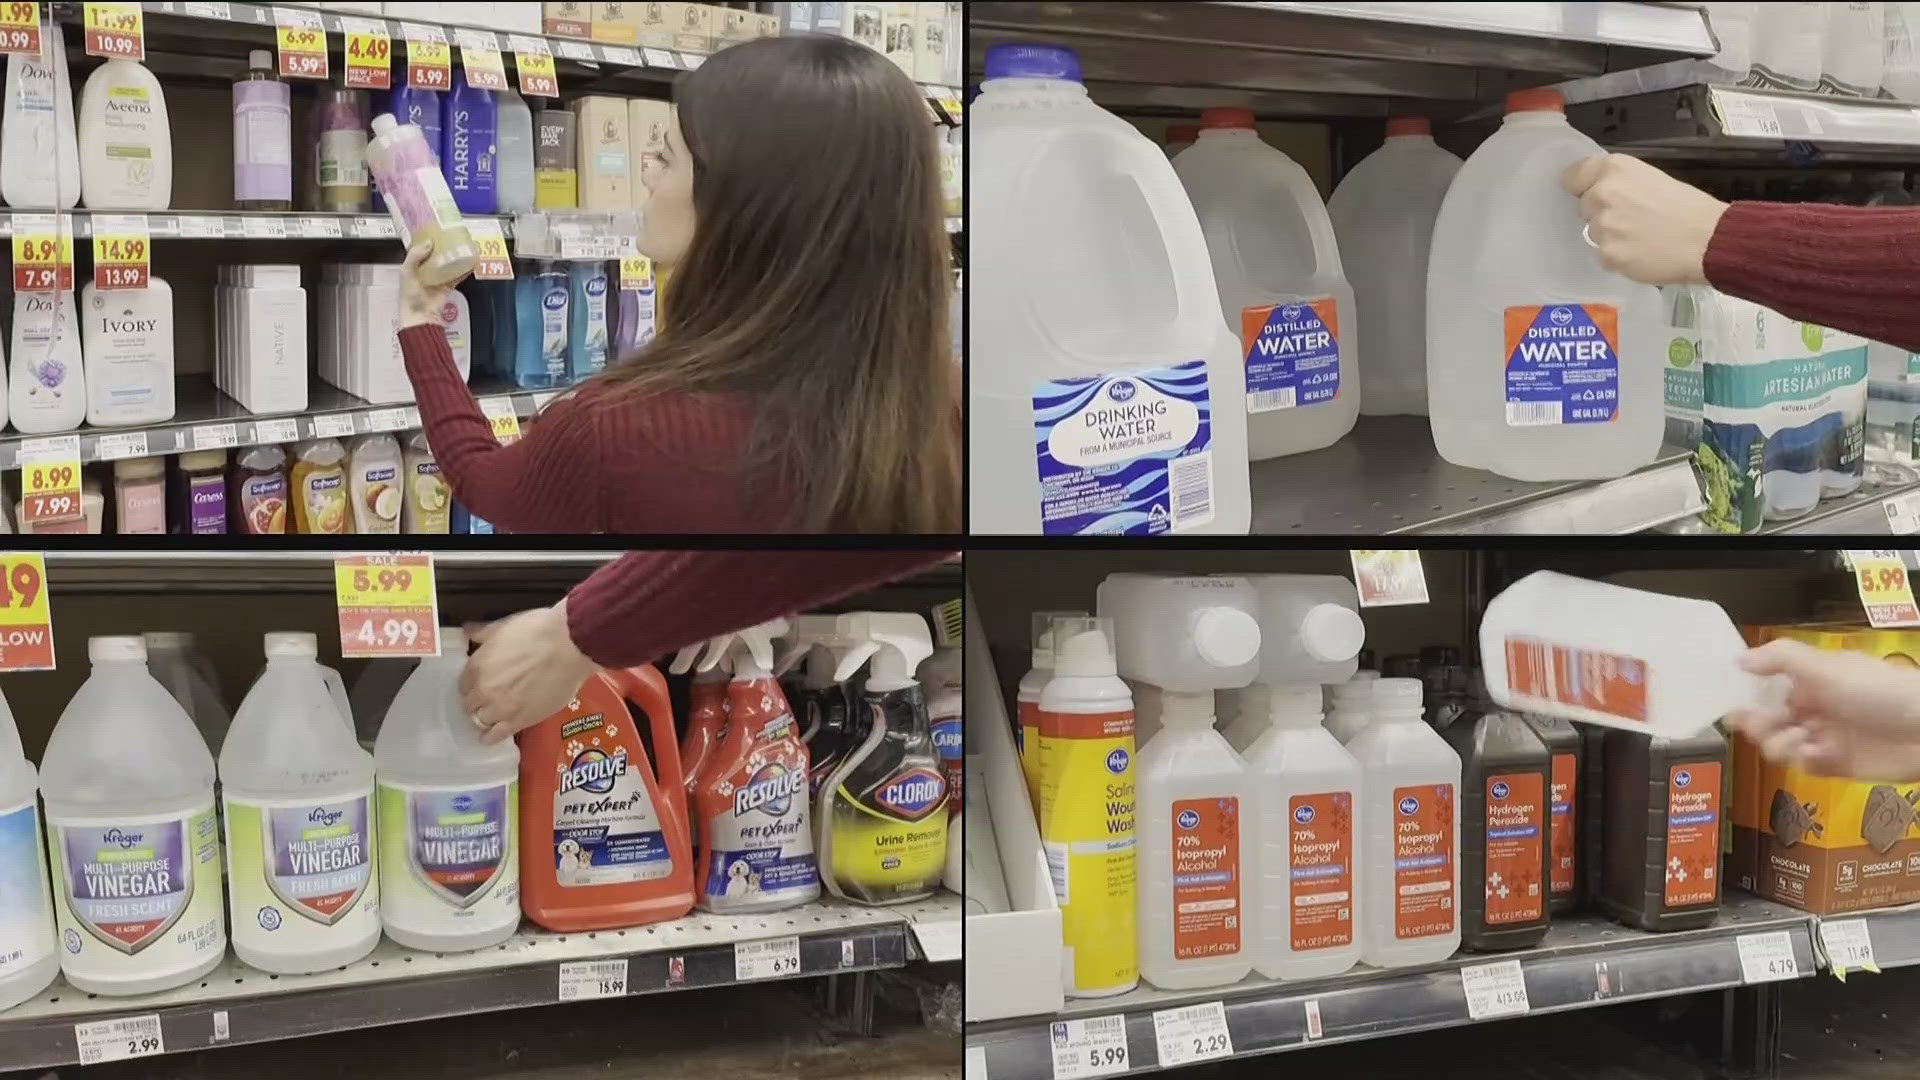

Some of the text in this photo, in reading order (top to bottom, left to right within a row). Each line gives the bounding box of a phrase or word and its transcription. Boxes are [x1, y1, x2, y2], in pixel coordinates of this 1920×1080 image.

[97, 35, 133, 53] 10.99
[286, 31, 316, 45] 6.99
[349, 37, 388, 60] 4.49
[288, 57, 319, 73] 5.99
[349, 76, 372, 84] PRICE
[416, 69, 443, 84] 5.99
[473, 71, 499, 85] 5.99
[527, 78, 550, 91] 5.99
[105, 100, 151, 114] Aveeno
[100, 240, 144, 260] 14.99
[480, 262, 505, 275] 7.99
[624, 260, 646, 272] 6.99
[105, 269, 139, 285] 13.99
[102, 318, 157, 333] IVORY
[1264, 320, 1321, 335] DISTILLED
[1529, 325, 1596, 338] DISTILLED
[274, 321, 286, 365] NATIVE
[1257, 331, 1330, 356] WATER
[1520, 340, 1607, 362] WATER
[1085, 400, 1167, 428] DRINKING
[1099, 419, 1155, 441] WATER
[128, 445, 146, 454] 7.99
[1079, 431, 1172, 457] FROM A MUNICIPAL SOURCE
[32, 466, 72, 489] 8.99
[194, 491, 224, 504] Caress
[34, 496, 71, 516] 7.99
[367, 556, 398, 566] SALE
[353, 569, 412, 592] 5.99
[1861, 567, 1904, 592] 5.99
[358, 619, 419, 646] 4.99
[561, 756, 626, 793] RESOLVE
[736, 772, 803, 816] RESOLVE
[886, 780, 940, 805] CLOROX
[1671, 793, 1712, 806] Hydrogen
[563, 803, 586, 815] PET
[1489, 804, 1534, 817] Hydrogen
[1671, 803, 1707, 813] Peroxide
[309, 807, 343, 826] Kroger
[1489, 815, 1529, 827] Peroxide
[741, 827, 761, 838] PET
[1398, 821, 1420, 832] 70%
[103, 828, 144, 849] Kroger
[876, 835, 904, 846] Urine
[1177, 836, 1200, 847] 70%
[1293, 831, 1315, 840] 70%
[1398, 830, 1443, 845] Isopropyl
[424, 836, 499, 864] VINEGAR
[1177, 845, 1227, 860] Isopropyl
[1293, 840, 1340, 854] Isopropyl
[1398, 843, 1435, 856] Alcohol
[289, 845, 360, 874] VINEGAR
[1177, 860, 1217, 872] Alcohol
[1293, 853, 1331, 866] Alcohol
[1770, 855, 1811, 873] CHOCOLATE
[1862, 860, 1903, 873] CHOCOLATE
[84, 871, 170, 898] VINEGAR
[88, 901, 172, 918] FRESH SCENT
[1848, 945, 1869, 960] 11.49
[774, 957, 797, 972] 6.79
[1769, 959, 1793, 974] 4.79
[600, 980, 623, 994] 15.99
[128, 1037, 159, 1054] 2.99
[1193, 1034, 1227, 1054] 2.29
[1090, 1047, 1125, 1067] 5.99
